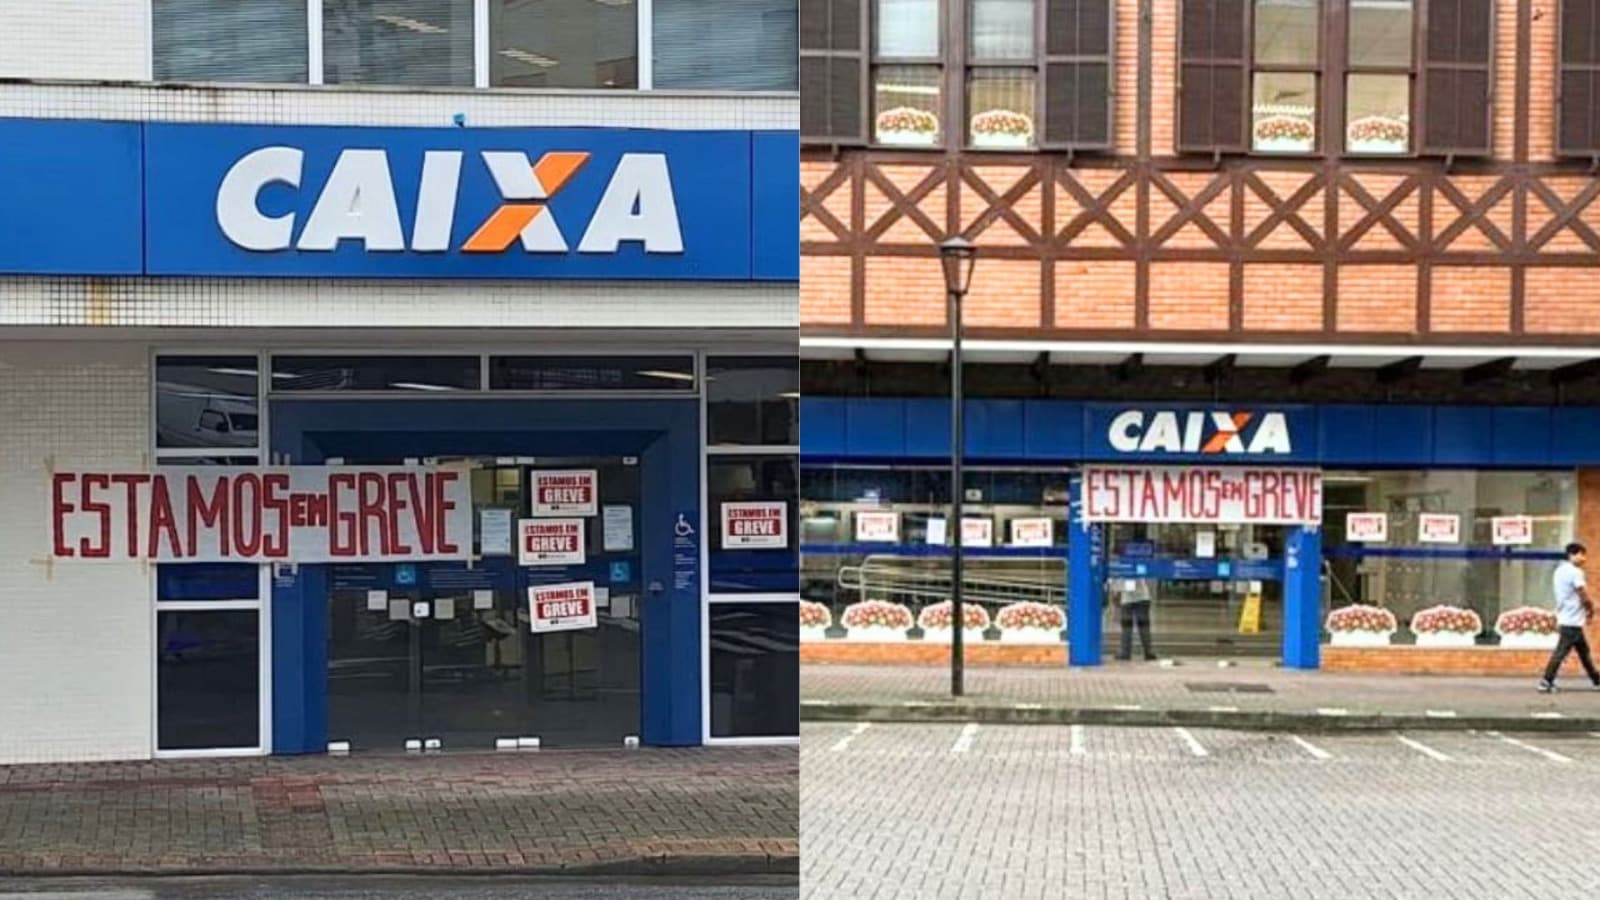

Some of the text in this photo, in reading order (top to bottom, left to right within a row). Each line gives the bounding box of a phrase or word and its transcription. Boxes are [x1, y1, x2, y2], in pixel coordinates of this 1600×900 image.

[216, 146, 684, 254] CAIXA
[1108, 410, 1292, 455] CAIXA
[544, 488, 585, 503] GREVE
[1087, 469, 1321, 521] ESTAMOS EM GREVE
[52, 473, 289, 558] ESTAMOS
[290, 493, 328, 527] EM
[329, 472, 458, 556] GREVE
[734, 519, 775, 535] GREVE
[531, 536, 573, 552] GREVE
[541, 602, 584, 617] GREVE
